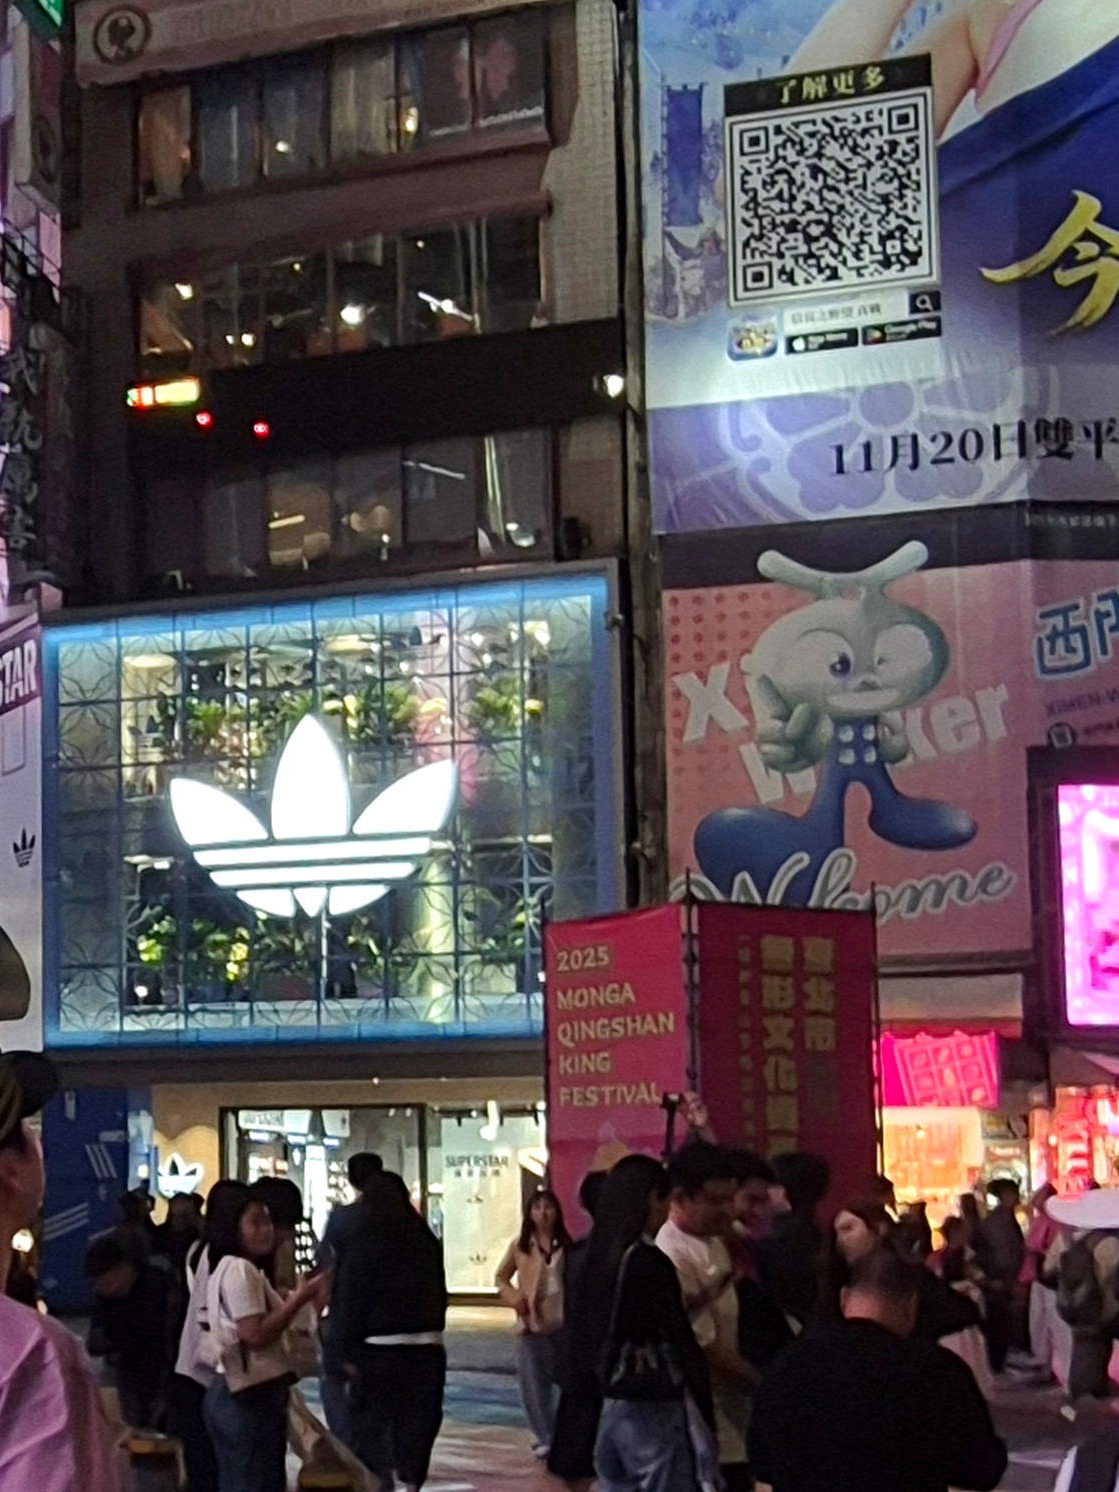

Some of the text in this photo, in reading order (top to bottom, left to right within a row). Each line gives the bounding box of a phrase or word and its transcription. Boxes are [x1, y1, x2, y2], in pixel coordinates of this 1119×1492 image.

[777, 65, 884, 104] 了解更多
[556, 945, 610, 972] 2025
[556, 982, 636, 1010] MONGA
[557, 1012, 675, 1047] QINGSHAN
[559, 1051, 611, 1075] KING
[559, 1083, 661, 1107] FESTIVAL
